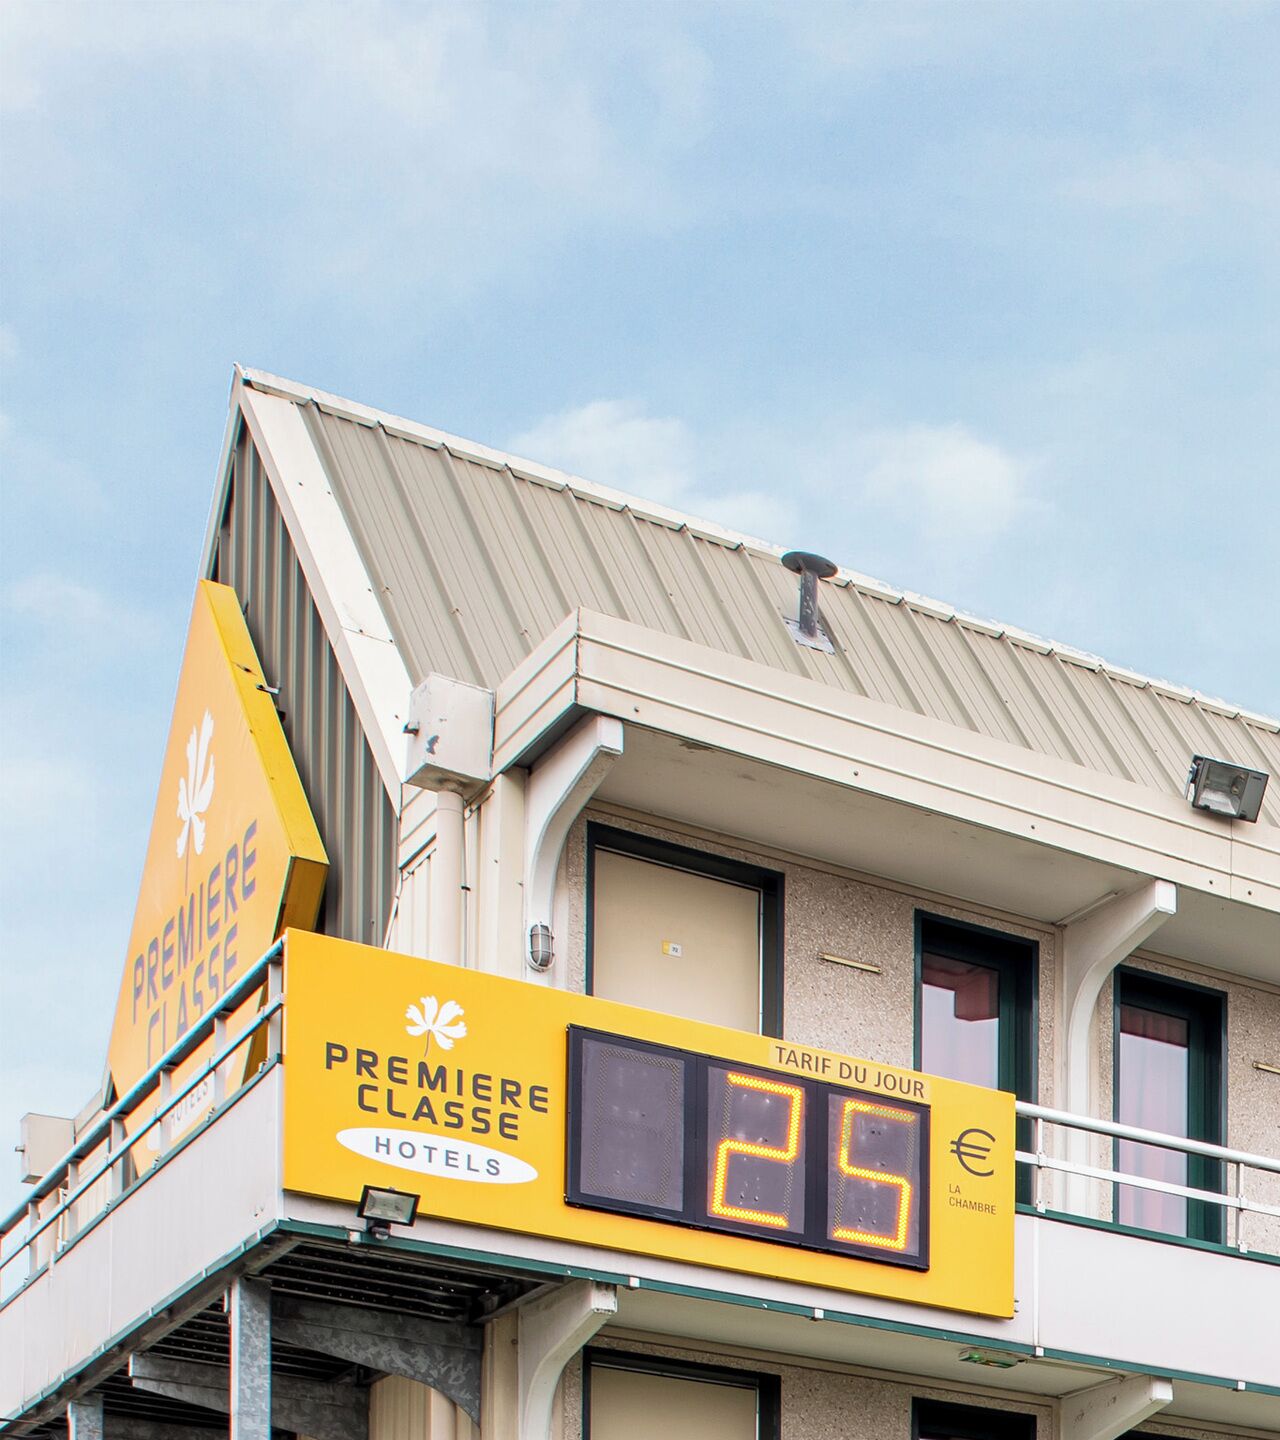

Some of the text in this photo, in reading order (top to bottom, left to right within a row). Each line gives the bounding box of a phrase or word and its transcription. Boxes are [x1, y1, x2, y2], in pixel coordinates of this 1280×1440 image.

[132, 818, 258, 1025] PREMIERE
[325, 1041, 549, 1114] PREMIERE
[775, 1045, 925, 1099] TARIF DU JOUR
[357, 1083, 519, 1141] CLASSE
[374, 1135, 501, 1177] HOTELS
[948, 1183, 961, 1195] LA
[948, 1196, 997, 1215] CHAMBRE
